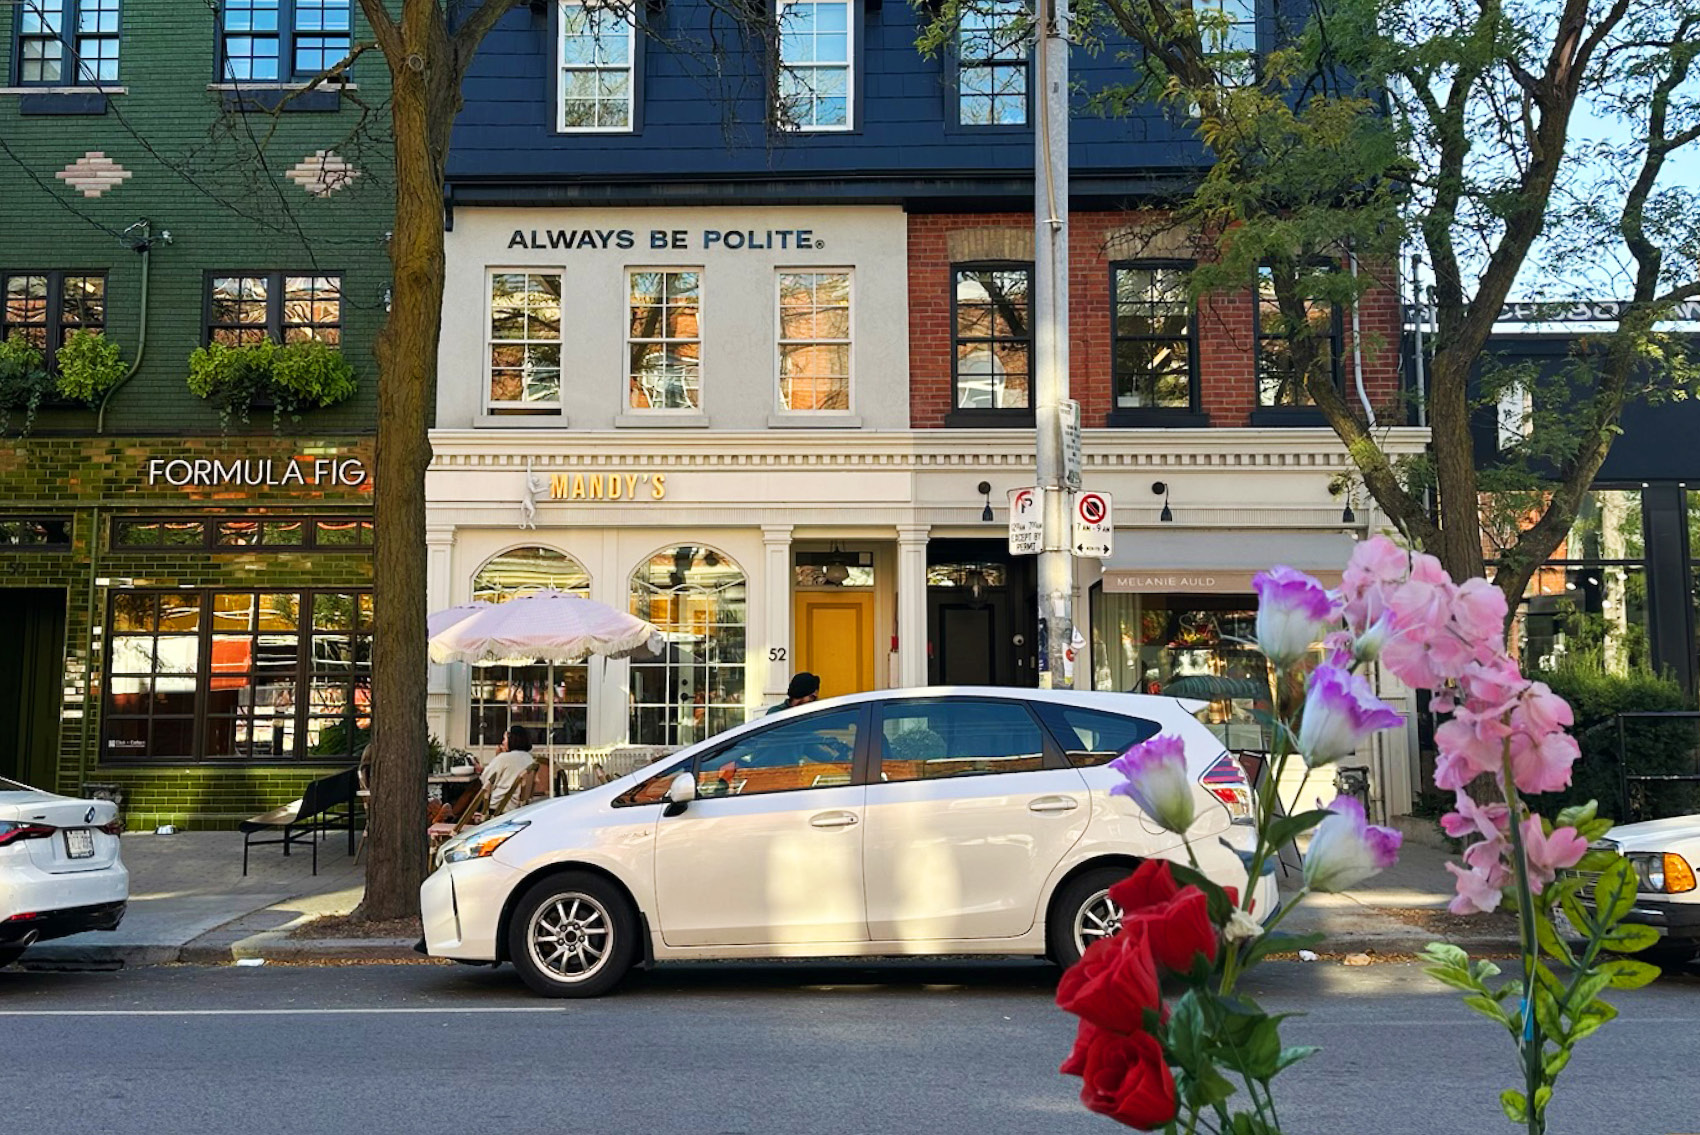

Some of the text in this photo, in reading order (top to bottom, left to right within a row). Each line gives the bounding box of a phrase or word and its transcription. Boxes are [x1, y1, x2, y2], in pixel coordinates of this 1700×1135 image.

[507, 229, 635, 249] ALWAYS
[650, 230, 688, 249] BE
[149, 458, 366, 486] FORMULA FIG
[551, 473, 666, 500] MANDY'S
[1117, 577, 1216, 587] MELANIE AULD
[768, 648, 787, 662] 52
